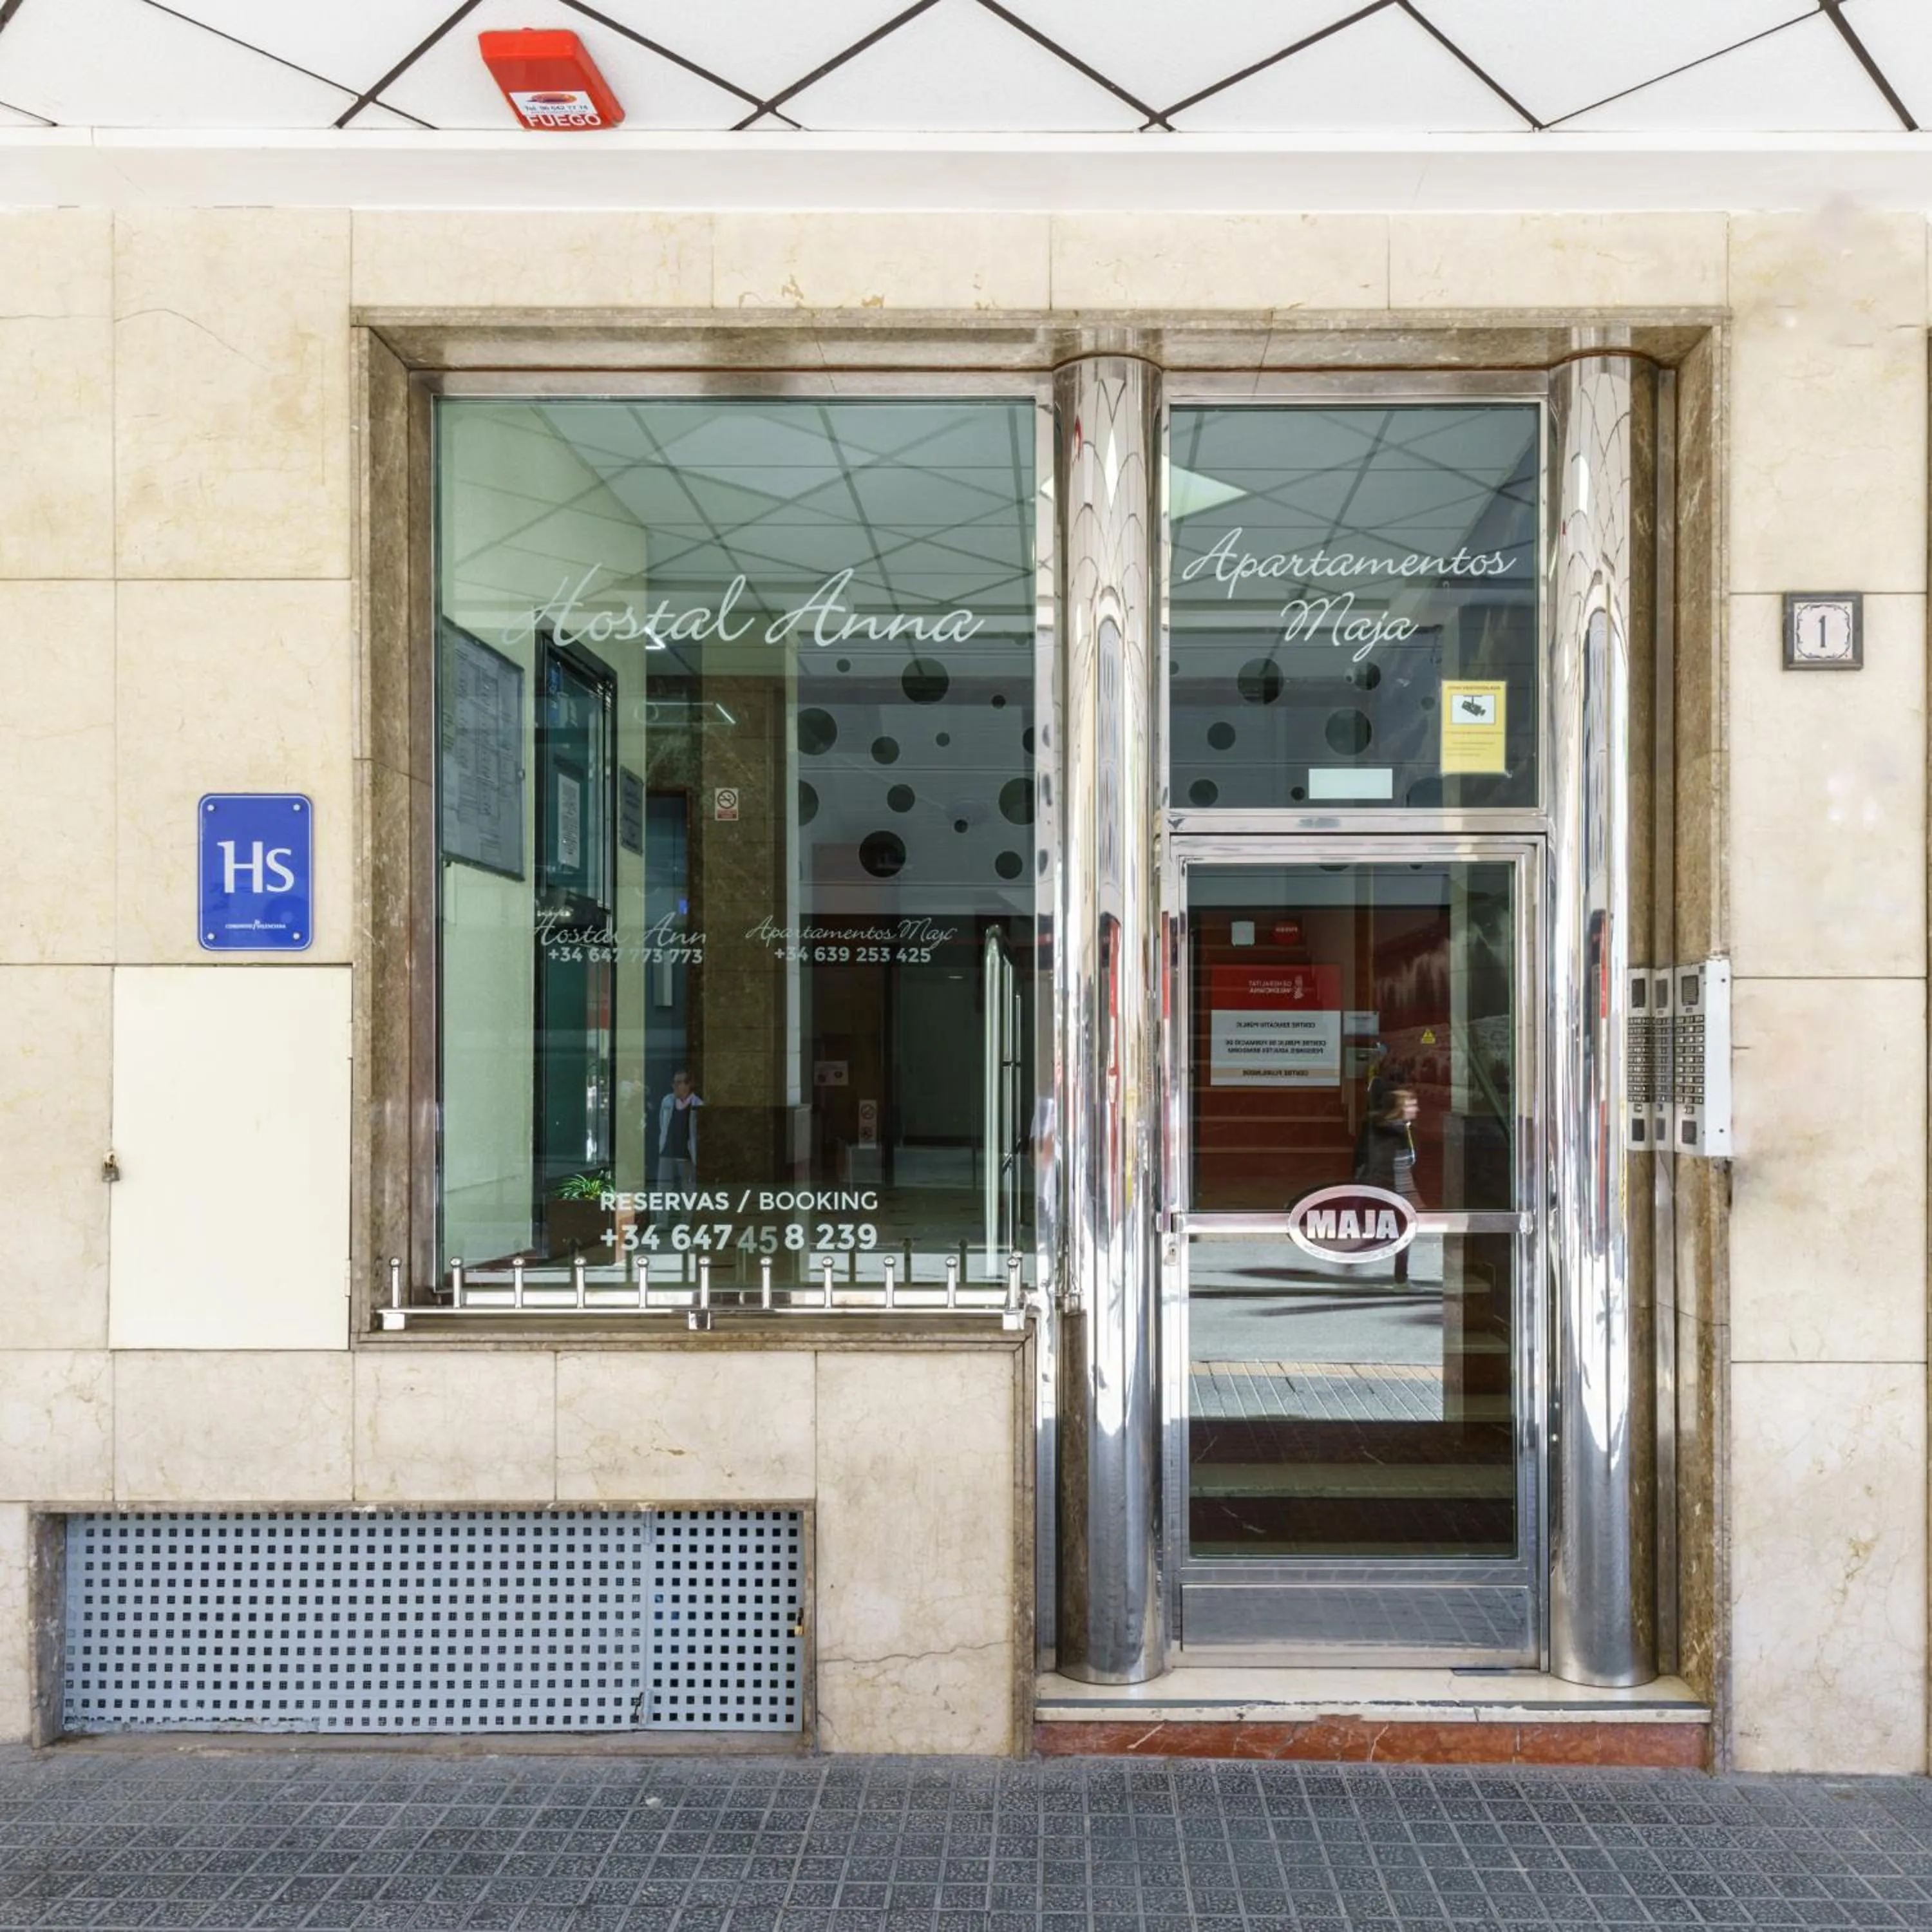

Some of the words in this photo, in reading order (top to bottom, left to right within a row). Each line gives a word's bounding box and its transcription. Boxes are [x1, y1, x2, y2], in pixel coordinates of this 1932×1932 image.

[526, 114, 601, 127] FUEGO
[1182, 527, 1517, 599] Apartamentos
[502, 562, 754, 647] Hostal
[764, 567, 985, 647] Anna
[1280, 591, 1419, 663] Maja
[1818, 614, 1826, 648] 1
[745, 914, 896, 948] Apartamentos
[548, 948, 583, 962] +34
[668, 948, 703, 963] 773
[774, 947, 809, 961] +34
[814, 947, 850, 962] 639
[856, 947, 891, 962] 253
[895, 947, 932, 963] 425
[600, 1191, 730, 1211] RESERVAS
[759, 1191, 878, 1211] BOOKING
[600, 1224, 661, 1251] +34
[670, 1224, 733, 1251] 647
[816, 1224, 878, 1251] 239
[1306, 1209, 1399, 1239] MAJA
